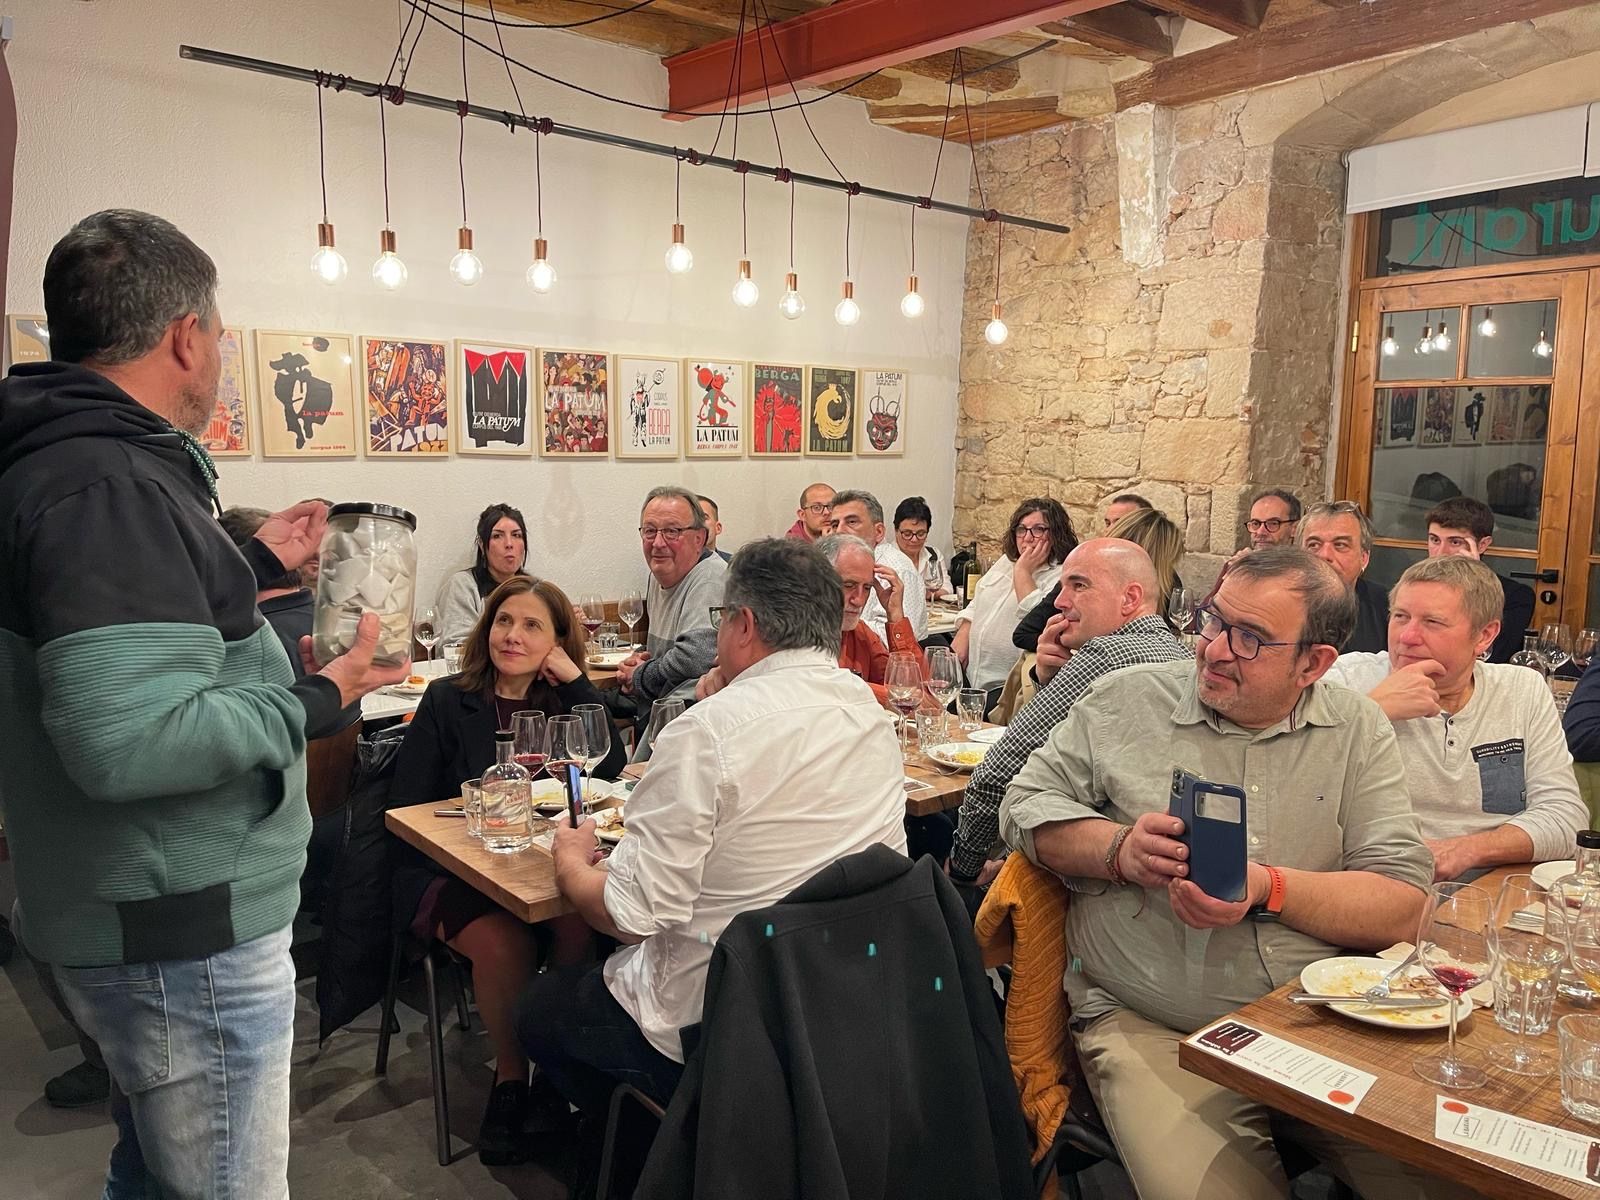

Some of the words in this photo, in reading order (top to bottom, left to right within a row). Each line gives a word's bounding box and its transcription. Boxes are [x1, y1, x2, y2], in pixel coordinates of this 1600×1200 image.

[755, 368, 800, 381] BERGA
[876, 372, 884, 380] LA
[884, 373, 903, 381] PATUM
[546, 390, 560, 410] LA
[564, 390, 606, 413] PATUM
[472, 416, 486, 425] LA
[487, 416, 521, 432] PATUM
[648, 408, 671, 436] BERGA
[391, 423, 448, 452] PATUM
[696, 429, 709, 442] LA
[711, 429, 739, 442] PATUM
